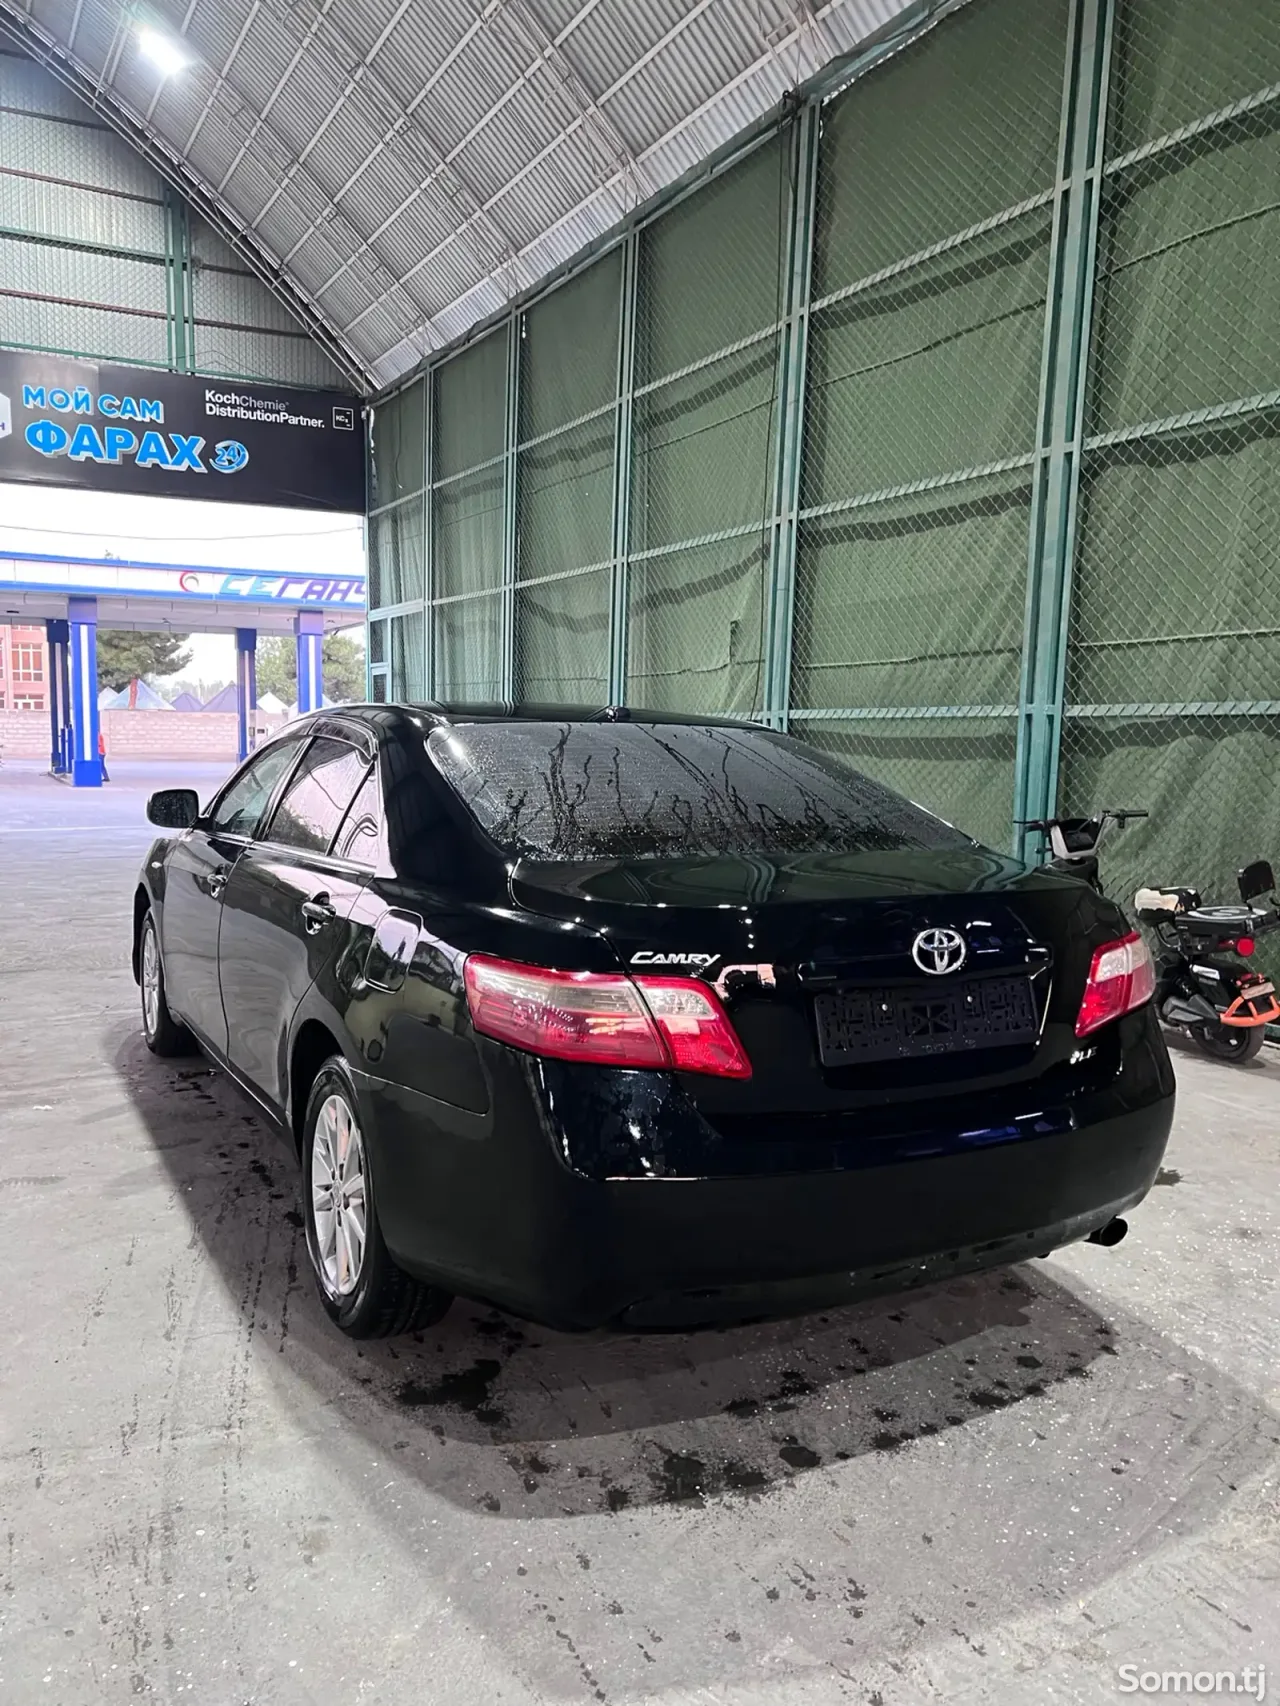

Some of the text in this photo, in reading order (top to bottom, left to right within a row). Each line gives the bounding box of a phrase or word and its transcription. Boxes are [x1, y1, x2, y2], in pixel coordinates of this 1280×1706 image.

[22, 384, 164, 424] МОЙ САМ
[205, 403, 325, 428] DistributionPartner.
[25, 419, 208, 473] ФАРАХ
[629, 951, 721, 966] CAMRY
